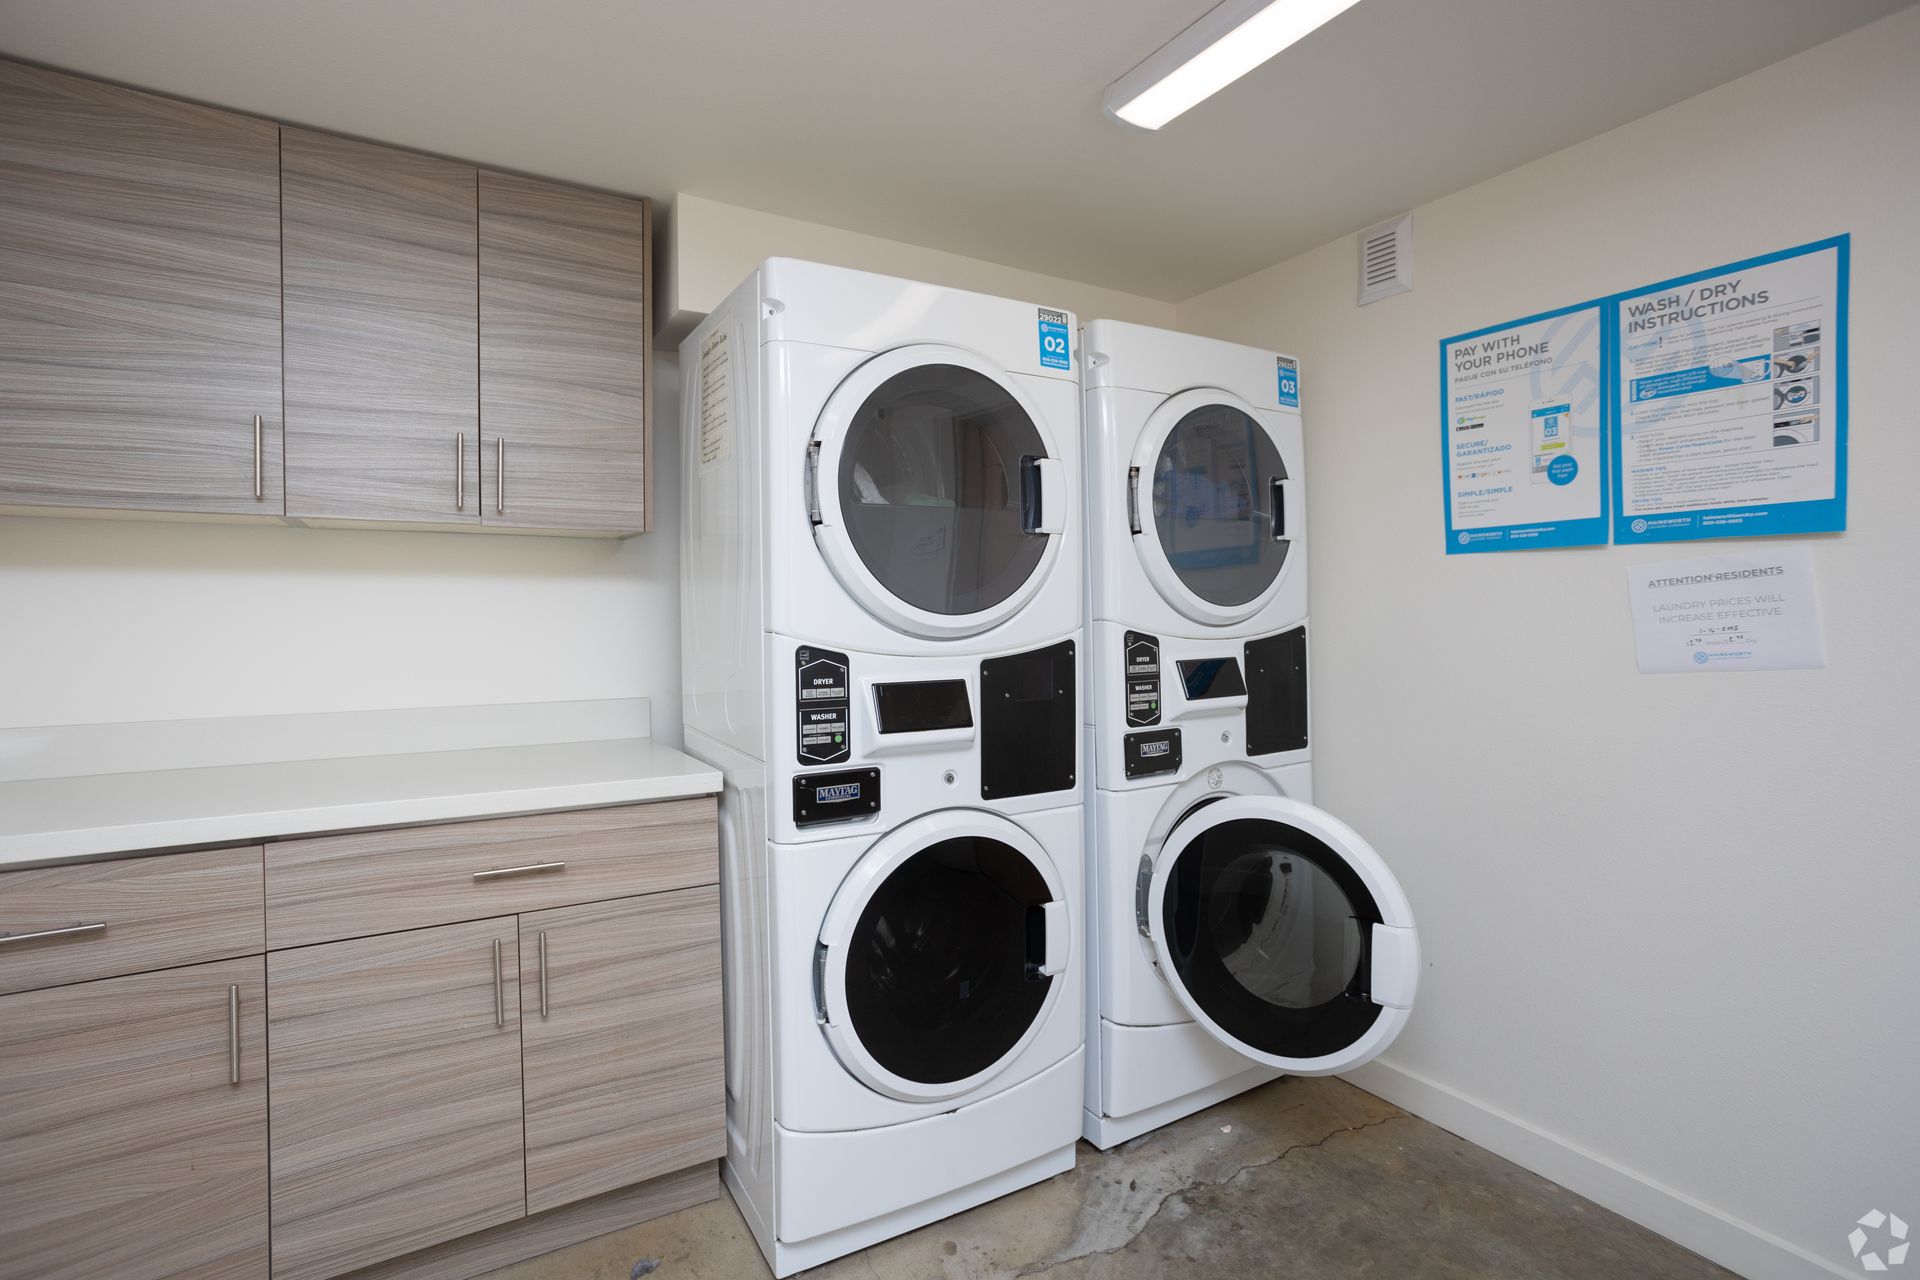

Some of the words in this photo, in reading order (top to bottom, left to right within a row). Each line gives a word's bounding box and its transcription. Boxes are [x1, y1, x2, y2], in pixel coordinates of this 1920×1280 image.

[1628, 295, 1680, 318] WASH
[1700, 280, 1741, 301] DRY
[1629, 290, 1769, 333] INSTRUCTIONS
[1044, 336, 1065, 354] 02
[1454, 345, 1477, 360] PAY
[1482, 334, 1520, 352] WITH
[1455, 356, 1492, 372] YOUR
[1497, 342, 1549, 361] PHONE
[1454, 371, 1478, 383] PAGUE
[1481, 367, 1497, 378] CON
[1282, 380, 1295, 394] 03
[1455, 389, 1504, 403] FAST/RÁPIDO
[1456, 440, 1488, 450] SECURE/
[1457, 444, 1512, 457] GARANTIZADO
[1458, 486, 1512, 498] SIMPLE/SIMPLE
[1648, 574, 1712, 588] ATTENTION
[1716, 566, 1783, 581] RESIDENTS
[1653, 600, 1706, 613] LAUNDRY
[1709, 597, 1751, 607] PRICES
[1754, 594, 1786, 602] WILL
[1659, 613, 1714, 624] INCREASE
[1717, 607, 1782, 620] EFFECTIVE
[1142, 743, 1168, 752] MAYTAG
[819, 785, 859, 798] MAYTAG
